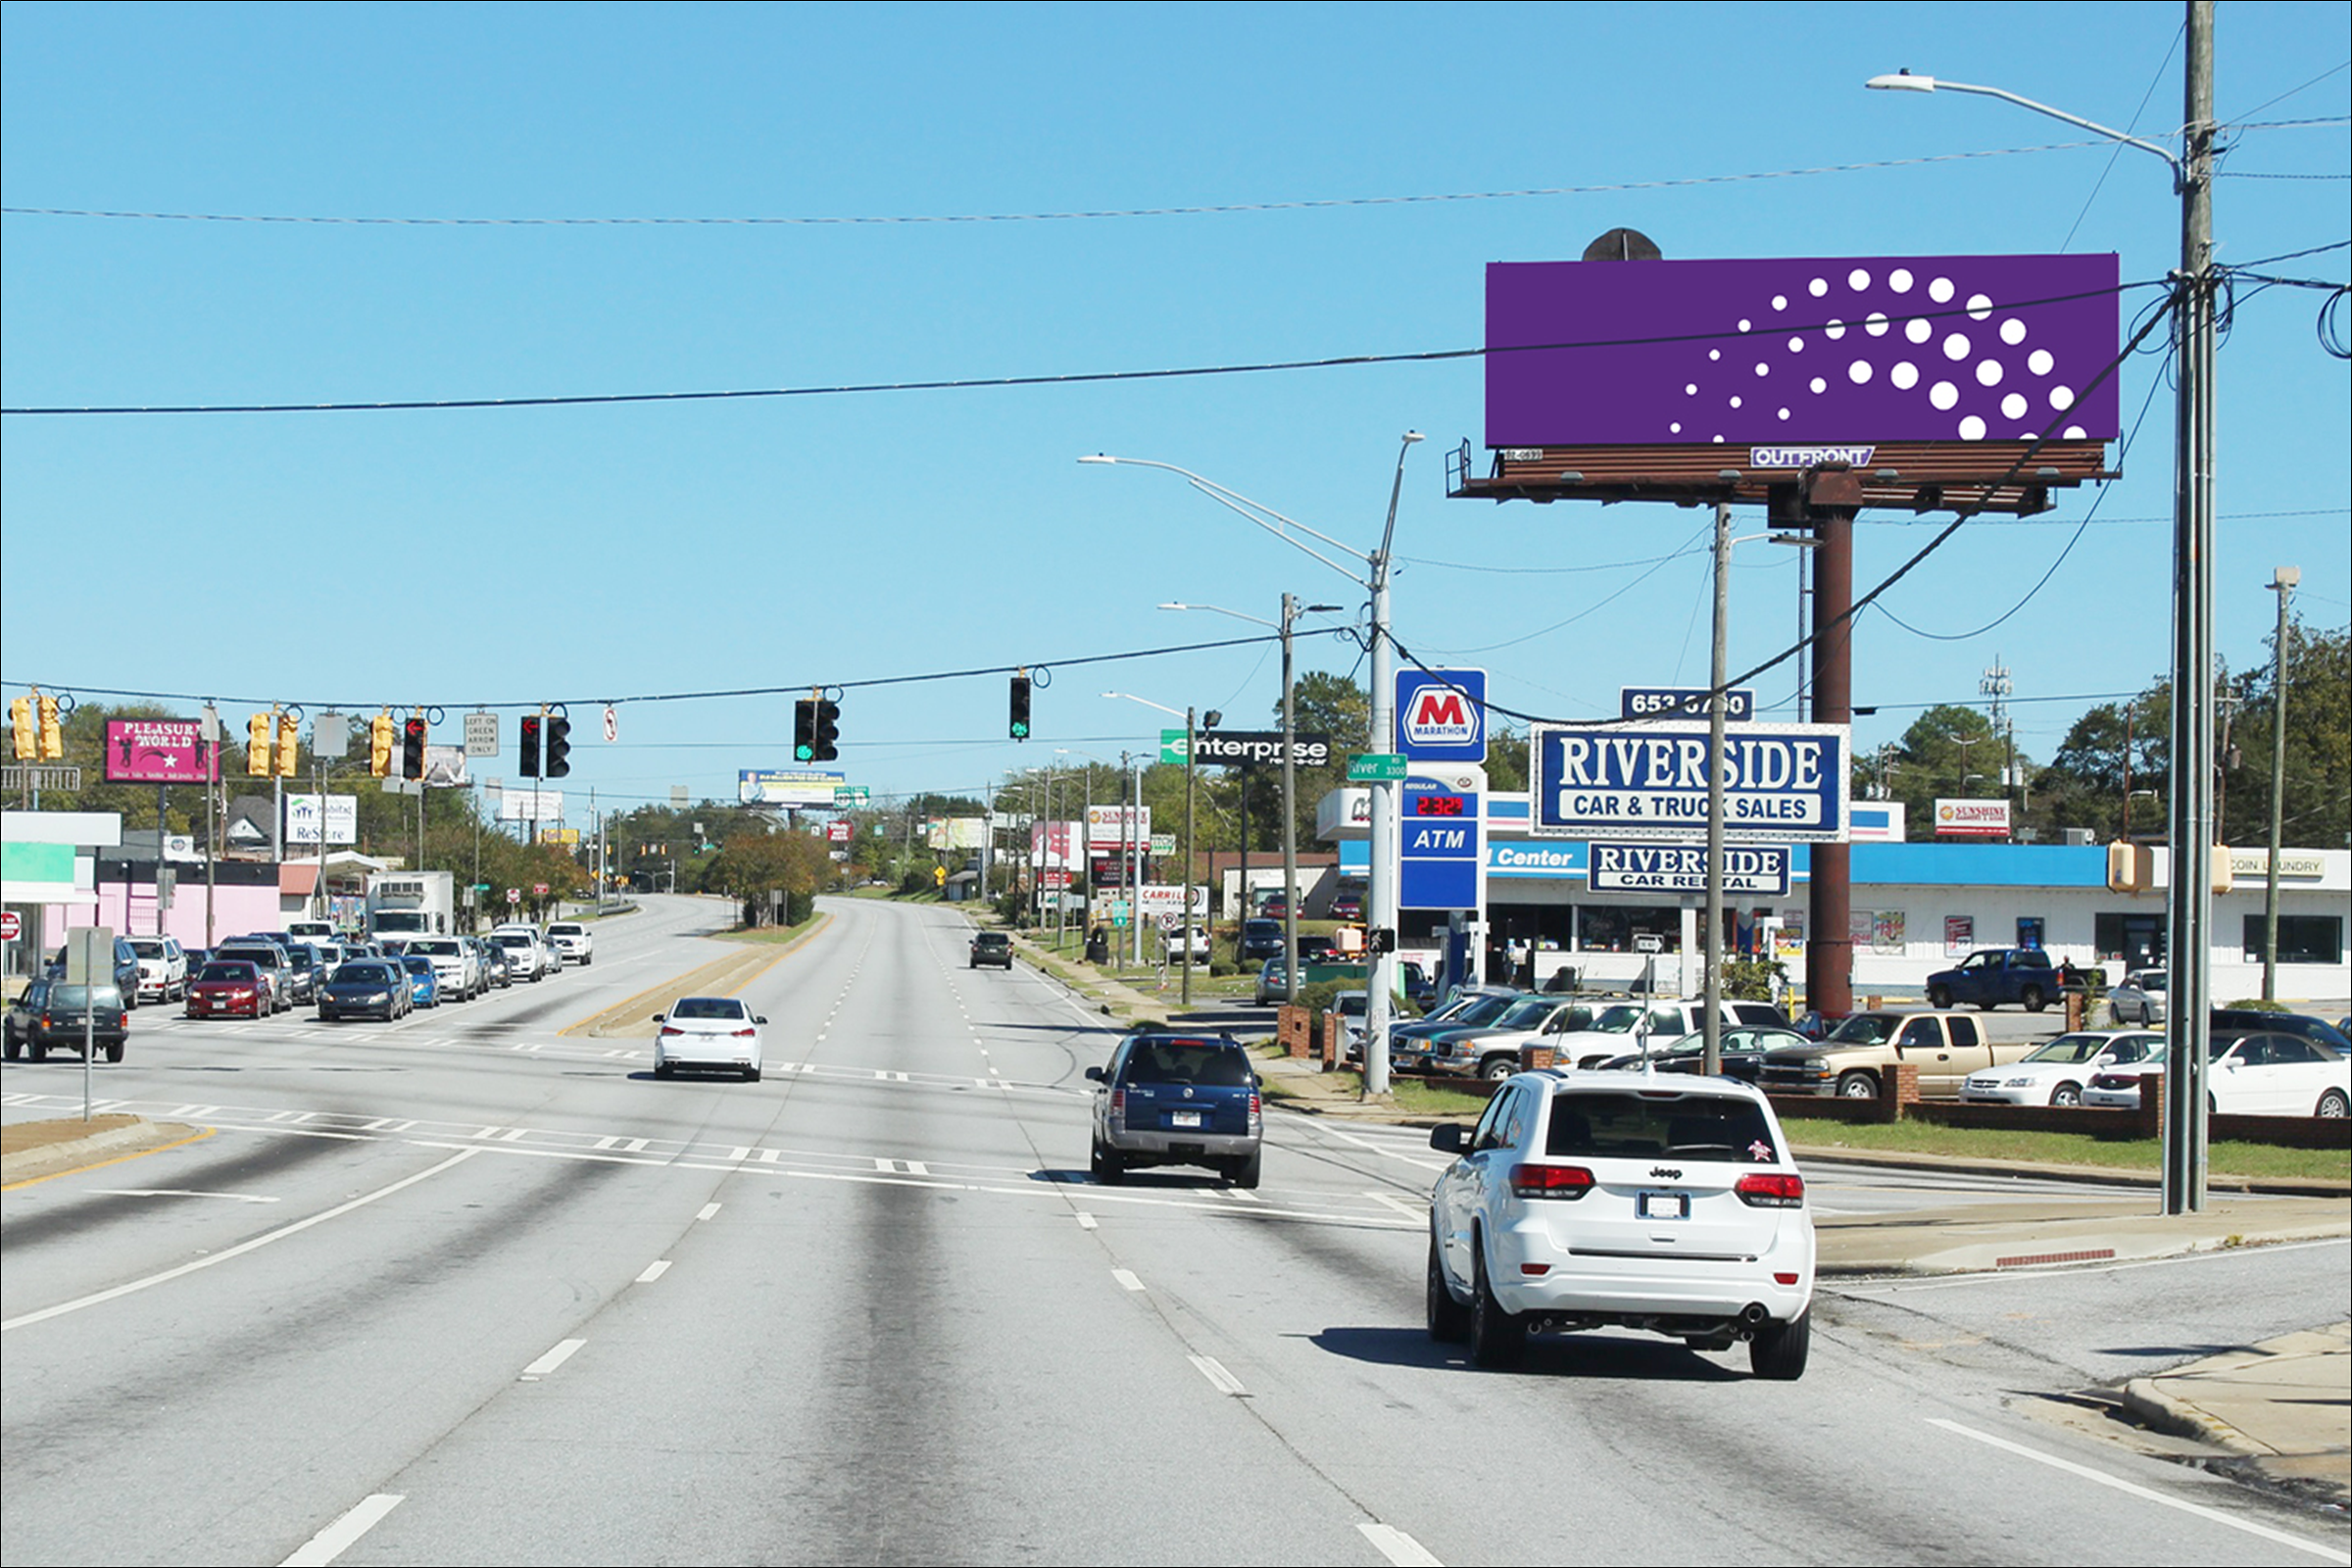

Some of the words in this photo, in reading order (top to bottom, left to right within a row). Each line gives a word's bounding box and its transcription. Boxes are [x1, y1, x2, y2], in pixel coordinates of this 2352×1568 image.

[1756, 449, 1867, 465] OUTFRONT
[1413, 726, 1468, 736] MARATHON
[135, 735, 193, 748] WORLD
[1170, 737, 1328, 761] enterprse
[1349, 760, 1378, 775] River
[1386, 765, 1405, 776] 3300
[1573, 795, 1620, 816] CAR
[1627, 796, 1643, 815] &
[1736, 798, 1807, 819] SALES
[1956, 807, 2005, 815] SUNSHINE
[297, 826, 345, 840] ReSore
[1413, 830, 1466, 850] ATM
[1497, 848, 1574, 866] Center
[2262, 859, 2321, 872] LUNDRY
[1620, 874, 1670, 886] CAR
[1672, 874, 1758, 888] RETAL
[1648, 1166, 1683, 1180] Jeep
